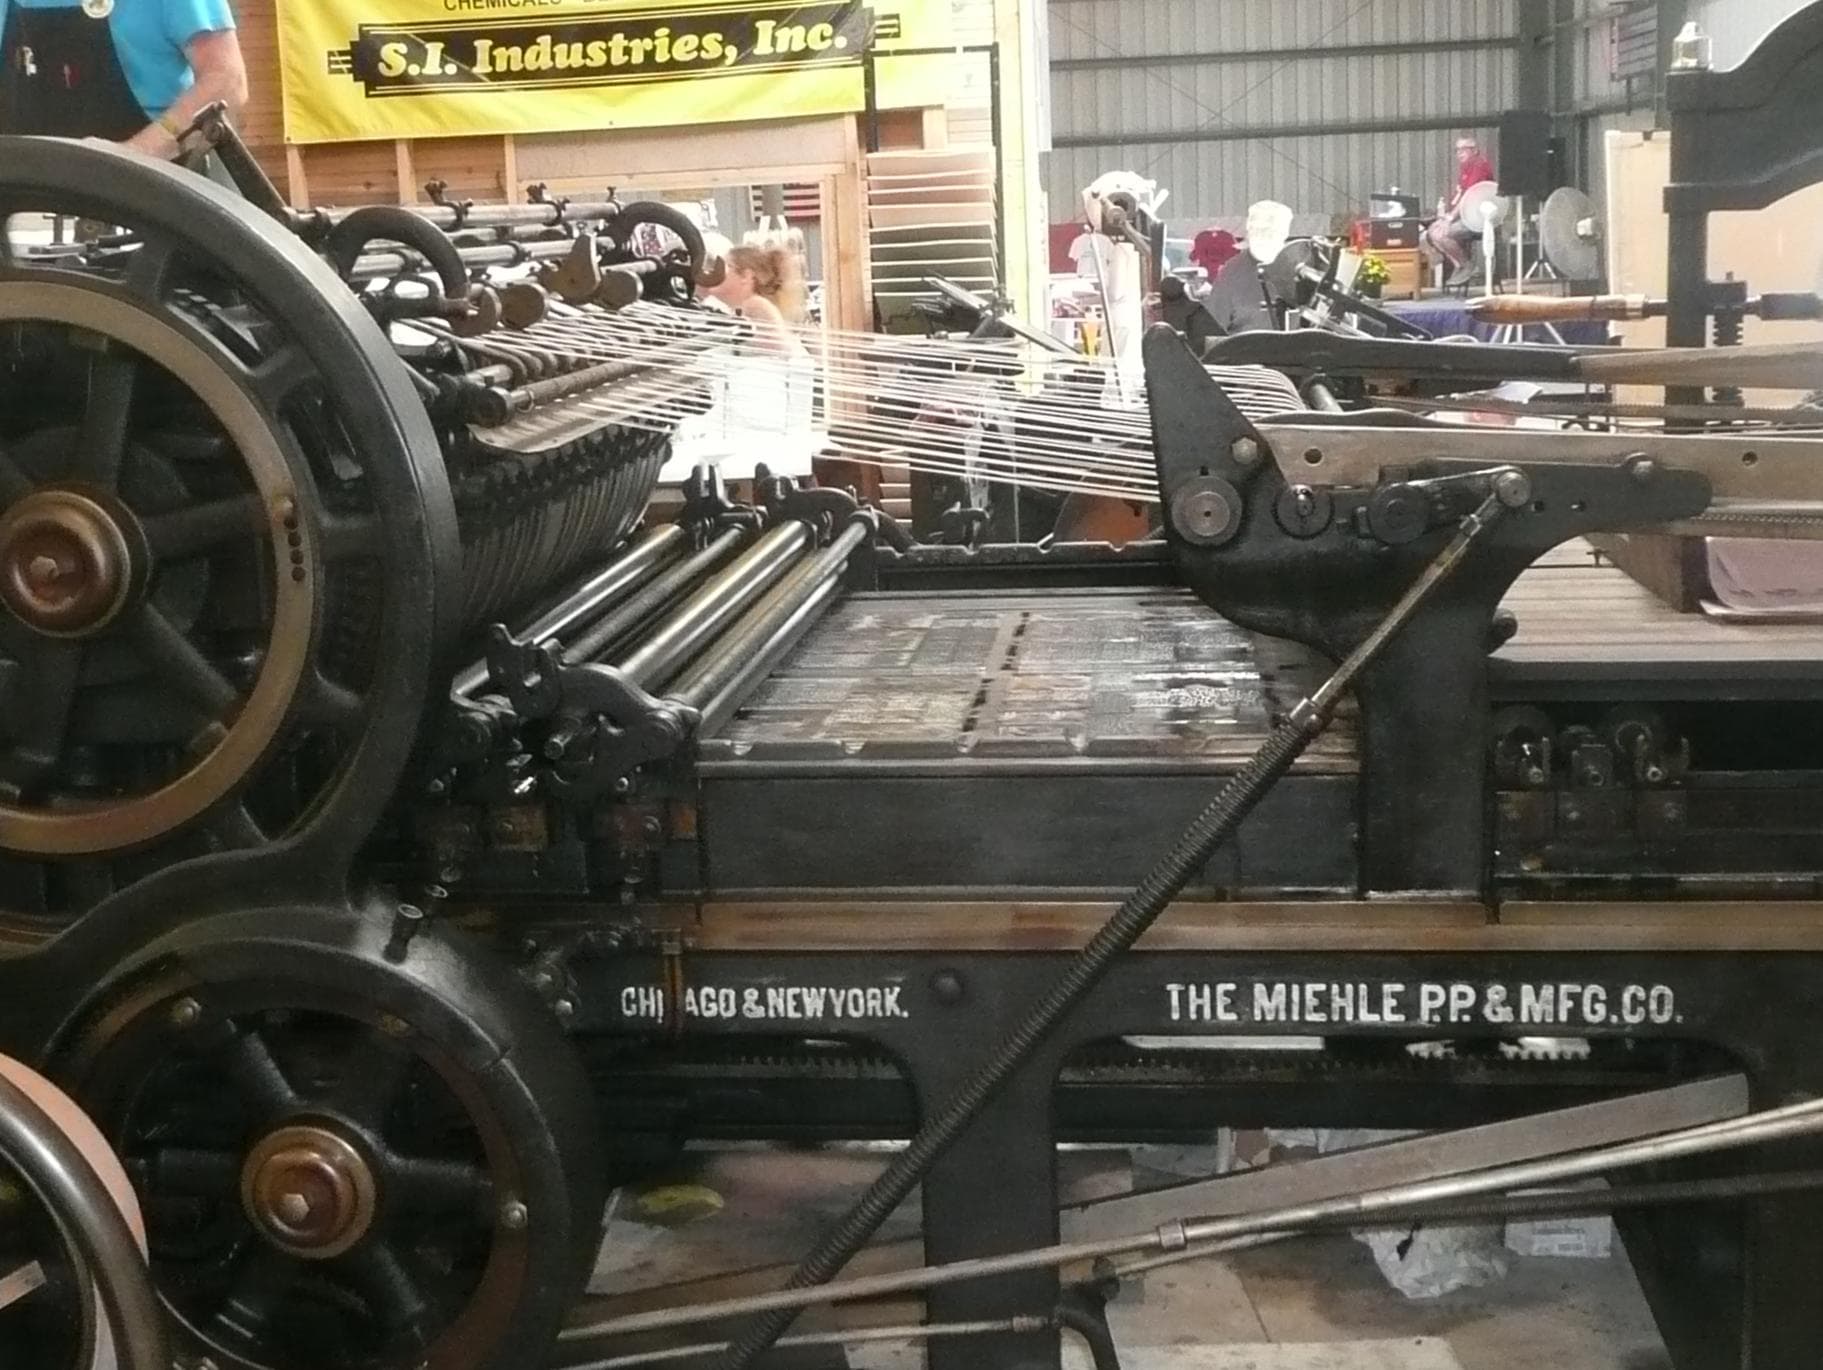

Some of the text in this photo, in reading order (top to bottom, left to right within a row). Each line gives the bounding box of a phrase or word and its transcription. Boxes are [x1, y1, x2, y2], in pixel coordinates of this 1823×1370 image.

[444, 0, 560, 11] CHEMI
[378, 20, 848, 77] S.I. Industries, Inc.
[621, 986, 737, 1018] CHIAGO
[1166, 983, 1238, 1021] THE
[1253, 983, 1405, 1022] MIEHLE
